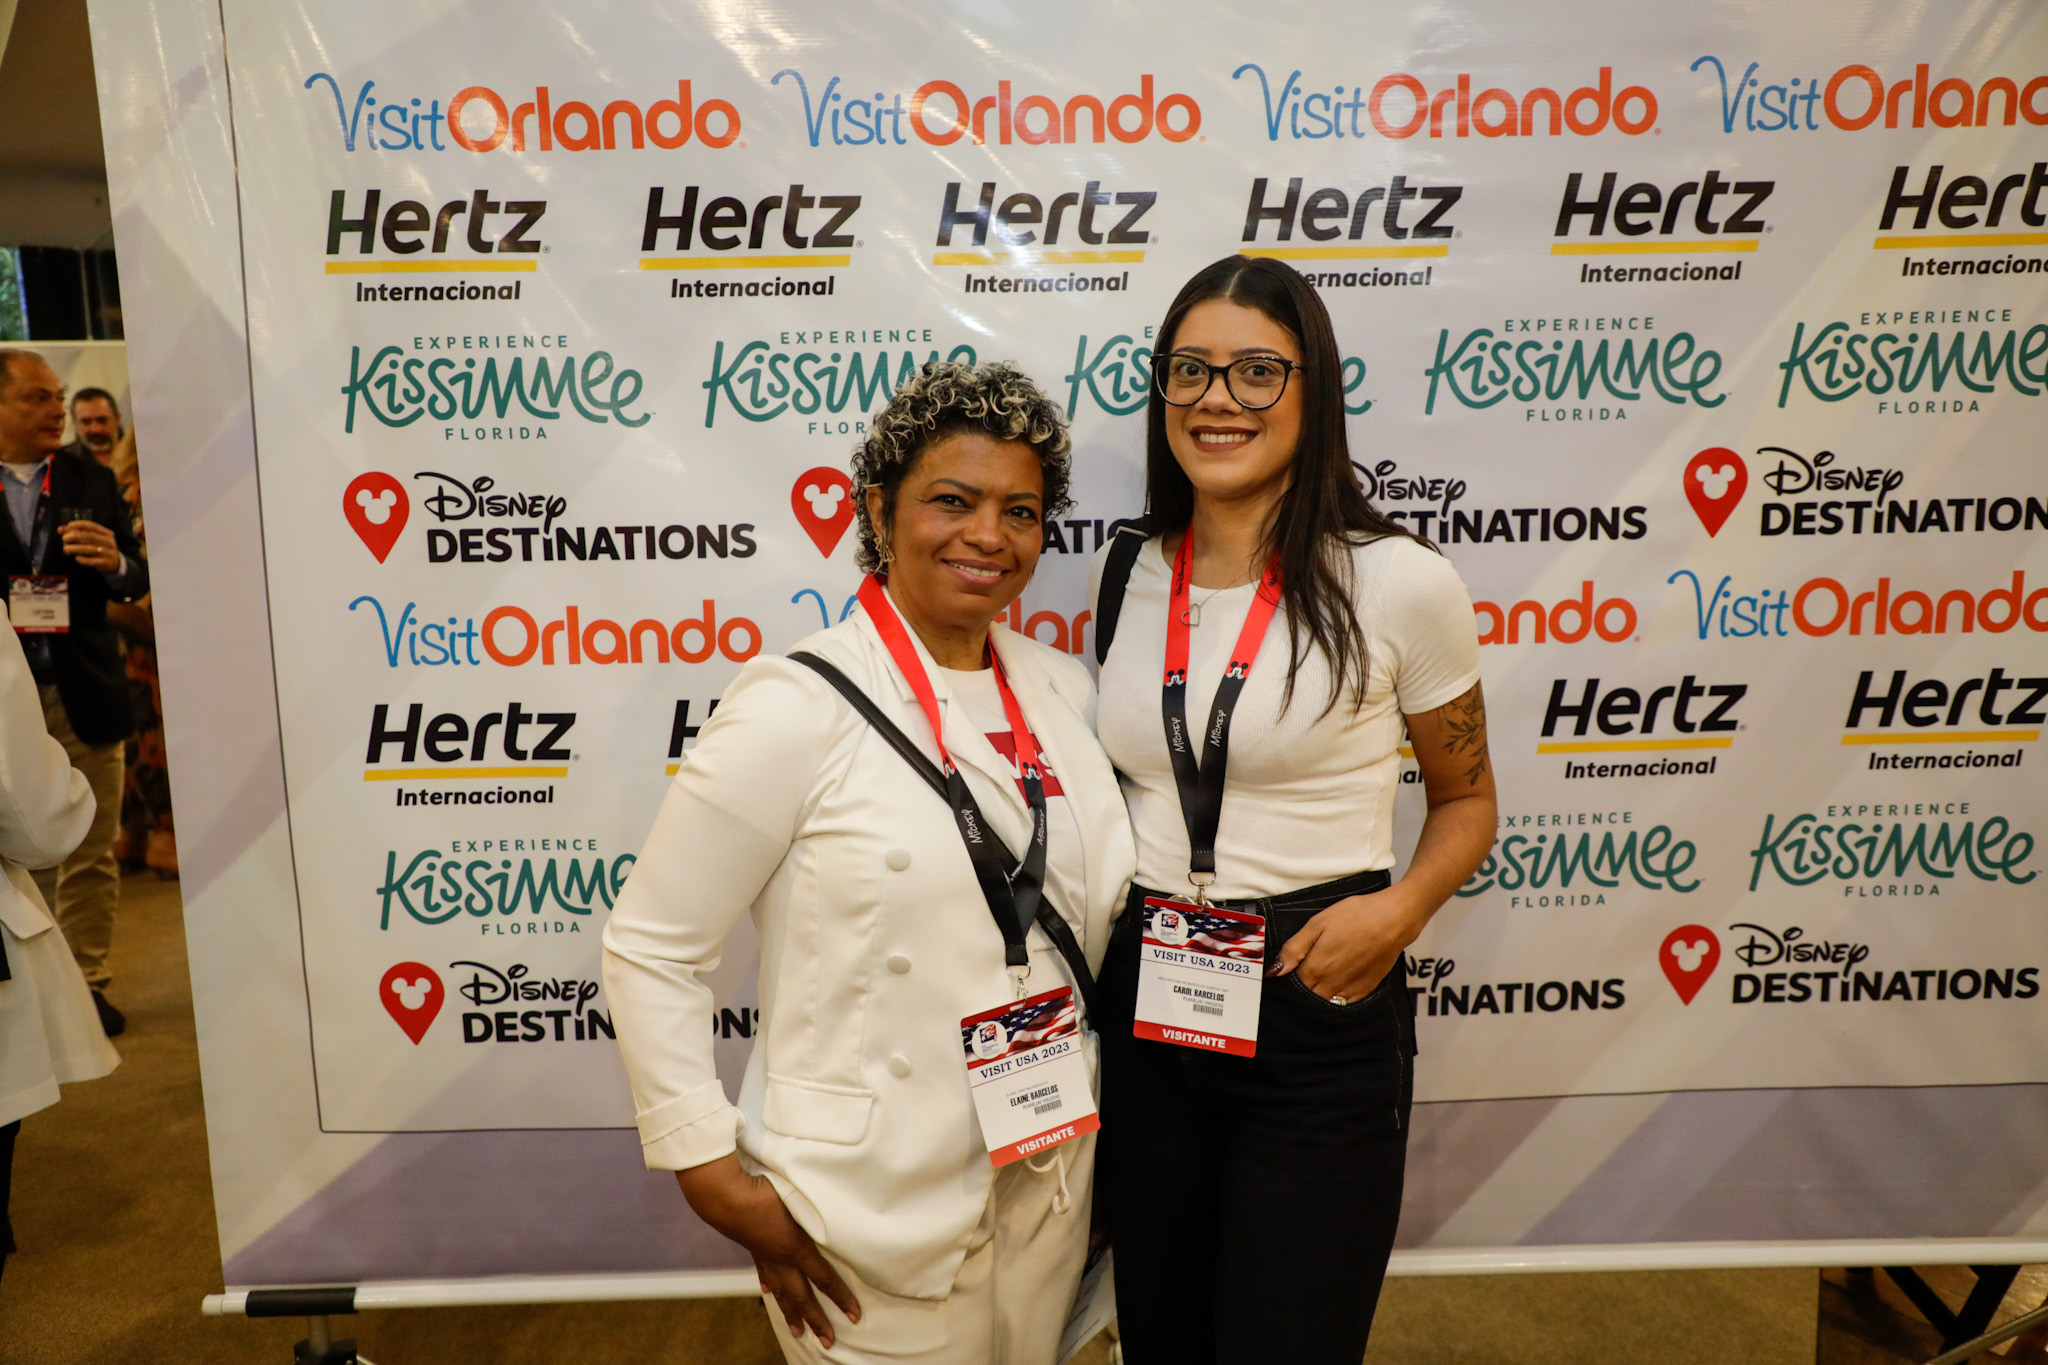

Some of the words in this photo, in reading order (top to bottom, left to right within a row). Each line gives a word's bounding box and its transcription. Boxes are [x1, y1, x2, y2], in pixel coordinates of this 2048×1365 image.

[1554, 170, 1775, 236] Hertz
[1879, 162, 2048, 230] Hert
[641, 184, 861, 251] Hertz
[936, 181, 1157, 246] Hertz
[1242, 176, 1463, 242] Hertz
[326, 189, 547, 255] Hertz
[1298, 267, 1432, 288] ernacional
[1581, 261, 1742, 283] Internacional
[1902, 254, 2048, 276] Internacion
[357, 280, 521, 302] Internacional
[671, 276, 834, 298] Internacional
[965, 271, 1128, 293] Internacional
[1505, 317, 1653, 332] EXPERIENCE
[1861, 309, 2011, 325] EXPERIENCE
[414, 336, 567, 349] EXPERIENCE
[781, 330, 931, 344] EXPERIENCE
[1425, 328, 1726, 415] Kissimmee
[1778, 322, 2048, 408] Kissimme
[341, 346, 651, 433] Kissimmee
[1527, 408, 1626, 421] FLORIDA
[1879, 400, 1979, 414] FLORIDA
[445, 427, 547, 440] FLORIDA
[808, 421, 867, 434] FLOR
[1757, 447, 1904, 499] Disney
[414, 472, 566, 534] Disney
[1761, 497, 2048, 536] DESTINATION
[427, 524, 757, 563] DESTINATIONS
[1541, 675, 1748, 737] Hertz
[1845, 668, 2048, 728] Hertz
[366, 702, 576, 764] Hertz
[1171, 716, 1186, 753] Mickey
[1210, 709, 1227, 748] Mickey
[1565, 756, 1717, 779] Internacional
[1869, 749, 2023, 770] Internacional
[396, 785, 553, 806] Internacional
[1828, 803, 1969, 816] EXPERIENCE
[961, 808, 983, 844] Mickey
[452, 839, 596, 852] EXPERIENCE
[1749, 814, 2037, 892] Kissimmee
[1512, 894, 1605, 908] FLORIDA
[1845, 885, 1939, 897] FLORIDA
[482, 922, 580, 935] FLORIDA
[1153, 949, 1187, 963] VISIT
[1190, 956, 1215, 968] USA
[1219, 961, 1250, 974] 2023
[1729, 923, 1869, 984] Disney
[449, 961, 598, 1018] Disney
[1173, 985, 1192, 996] CAROL
[1194, 989, 1225, 1002] BARCELOS
[1732, 968, 2040, 1004] DESTINATIONS
[1162, 1028, 1227, 1049] VISITANTE
[980, 1061, 1013, 1079] VISIT
[1015, 1052, 1040, 1068] USA
[1041, 1041, 1070, 1059] 2023
[1010, 1094, 1030, 1107] ELAINE
[1030, 1084, 1059, 1101] BARCELOS
[1016, 1125, 1076, 1155] VISITANTE
